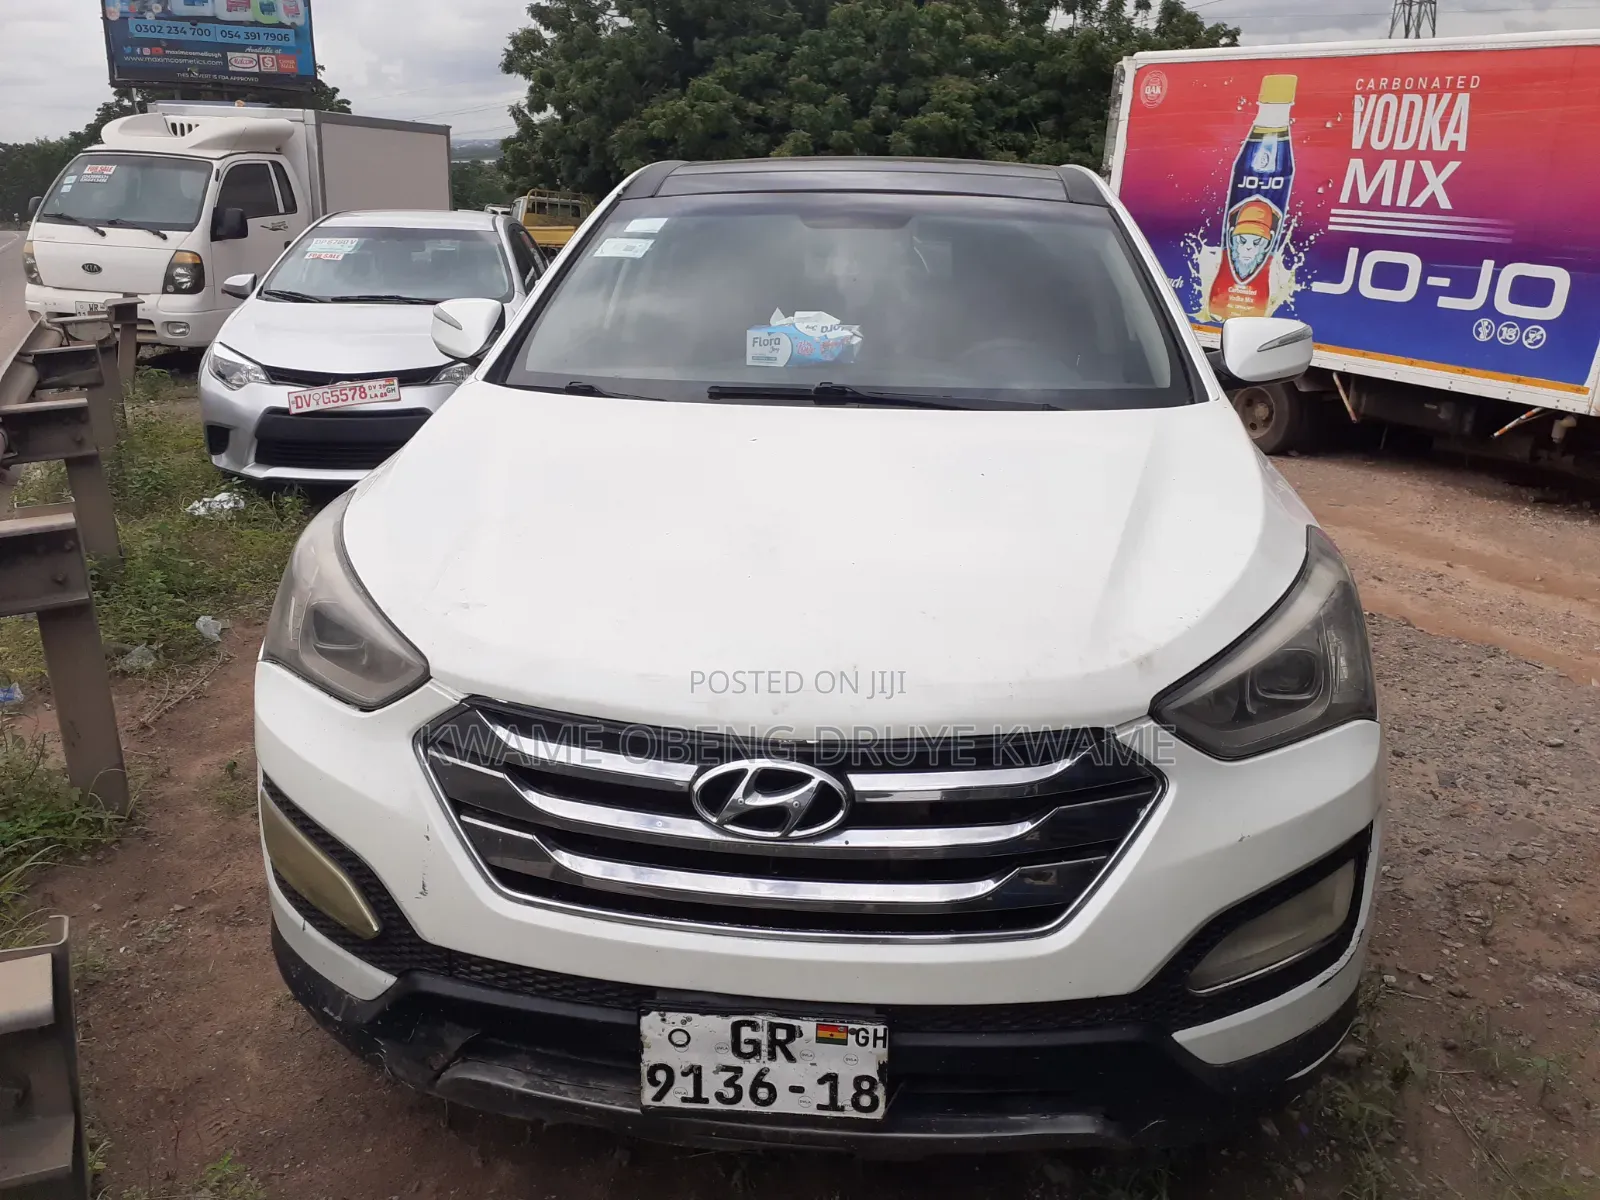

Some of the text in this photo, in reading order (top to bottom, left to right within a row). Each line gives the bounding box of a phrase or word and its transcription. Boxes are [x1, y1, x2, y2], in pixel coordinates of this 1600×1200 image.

[135, 24, 211, 37] 0302 234 700
[220, 30, 290, 42] 054 391 7906
[124, 56, 224, 66] www.maximcosmetics.com
[1355, 75, 1481, 91] CARBONATED
[1351, 92, 1470, 152] VODKA
[1238, 176, 1284, 190] JO-JO
[1338, 158, 1462, 210] MIX
[84, 264, 99, 272] KIA
[1310, 247, 1571, 320] JO-JO
[752, 337, 781, 348] Flora
[294, 386, 368, 410] DV G5578
[730, 1018, 800, 1063] GR
[854, 1027, 888, 1049] GH
[647, 1062, 880, 1114] 9136-18
